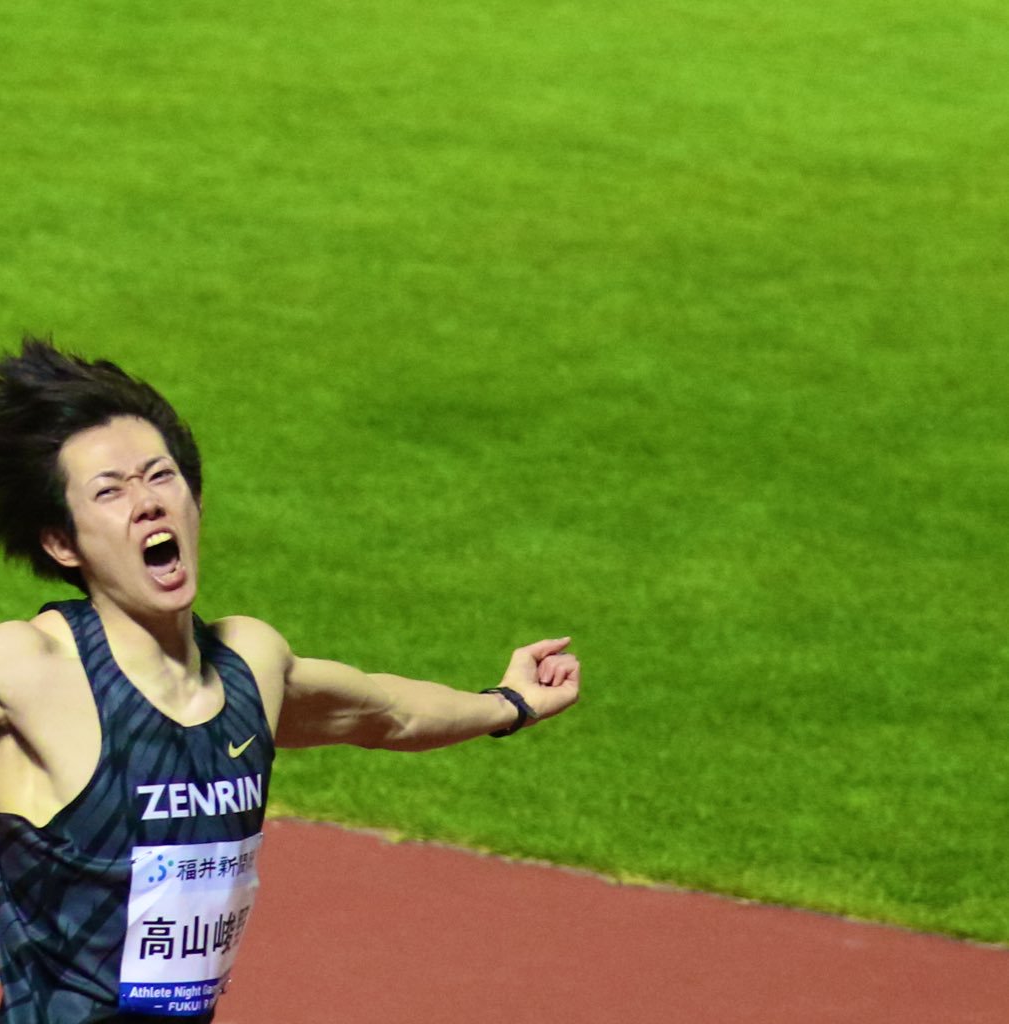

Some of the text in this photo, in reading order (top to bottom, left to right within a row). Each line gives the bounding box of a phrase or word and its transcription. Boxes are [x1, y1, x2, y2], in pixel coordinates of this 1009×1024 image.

[137, 774, 262, 820] ZENRIN
[129, 986, 171, 998] Athlete
[174, 985, 201, 1000] Night
